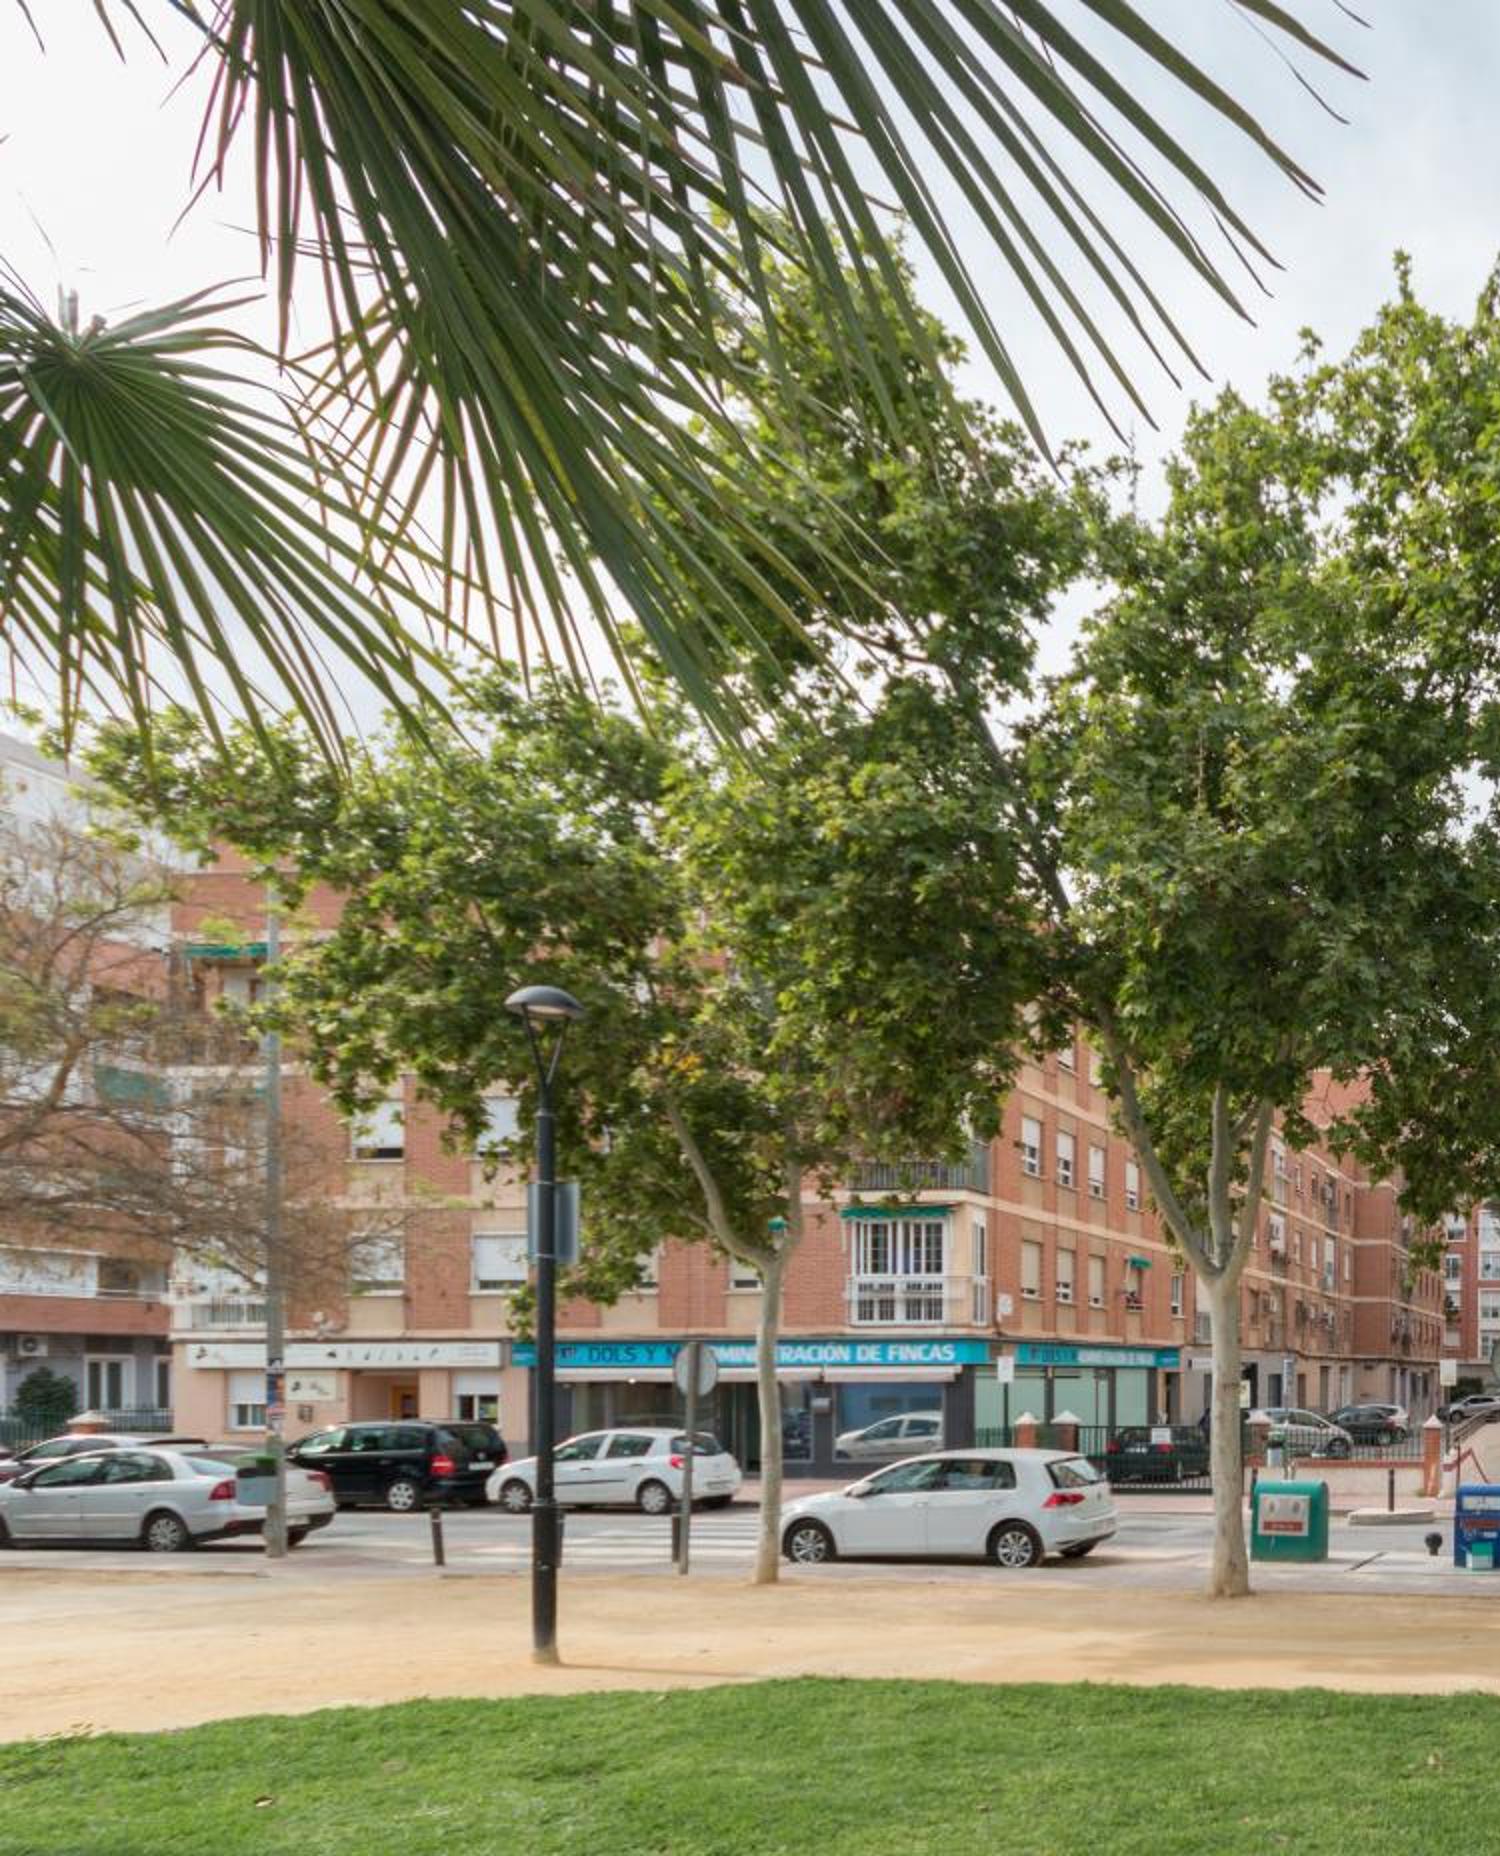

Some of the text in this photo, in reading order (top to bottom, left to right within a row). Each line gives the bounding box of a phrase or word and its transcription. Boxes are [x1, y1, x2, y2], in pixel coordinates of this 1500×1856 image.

[588, 1346, 637, 1363] DOLS
[646, 1346, 657, 1362] Y
[856, 1344, 882, 1361] DE
[887, 1343, 955, 1361] FINCAS
